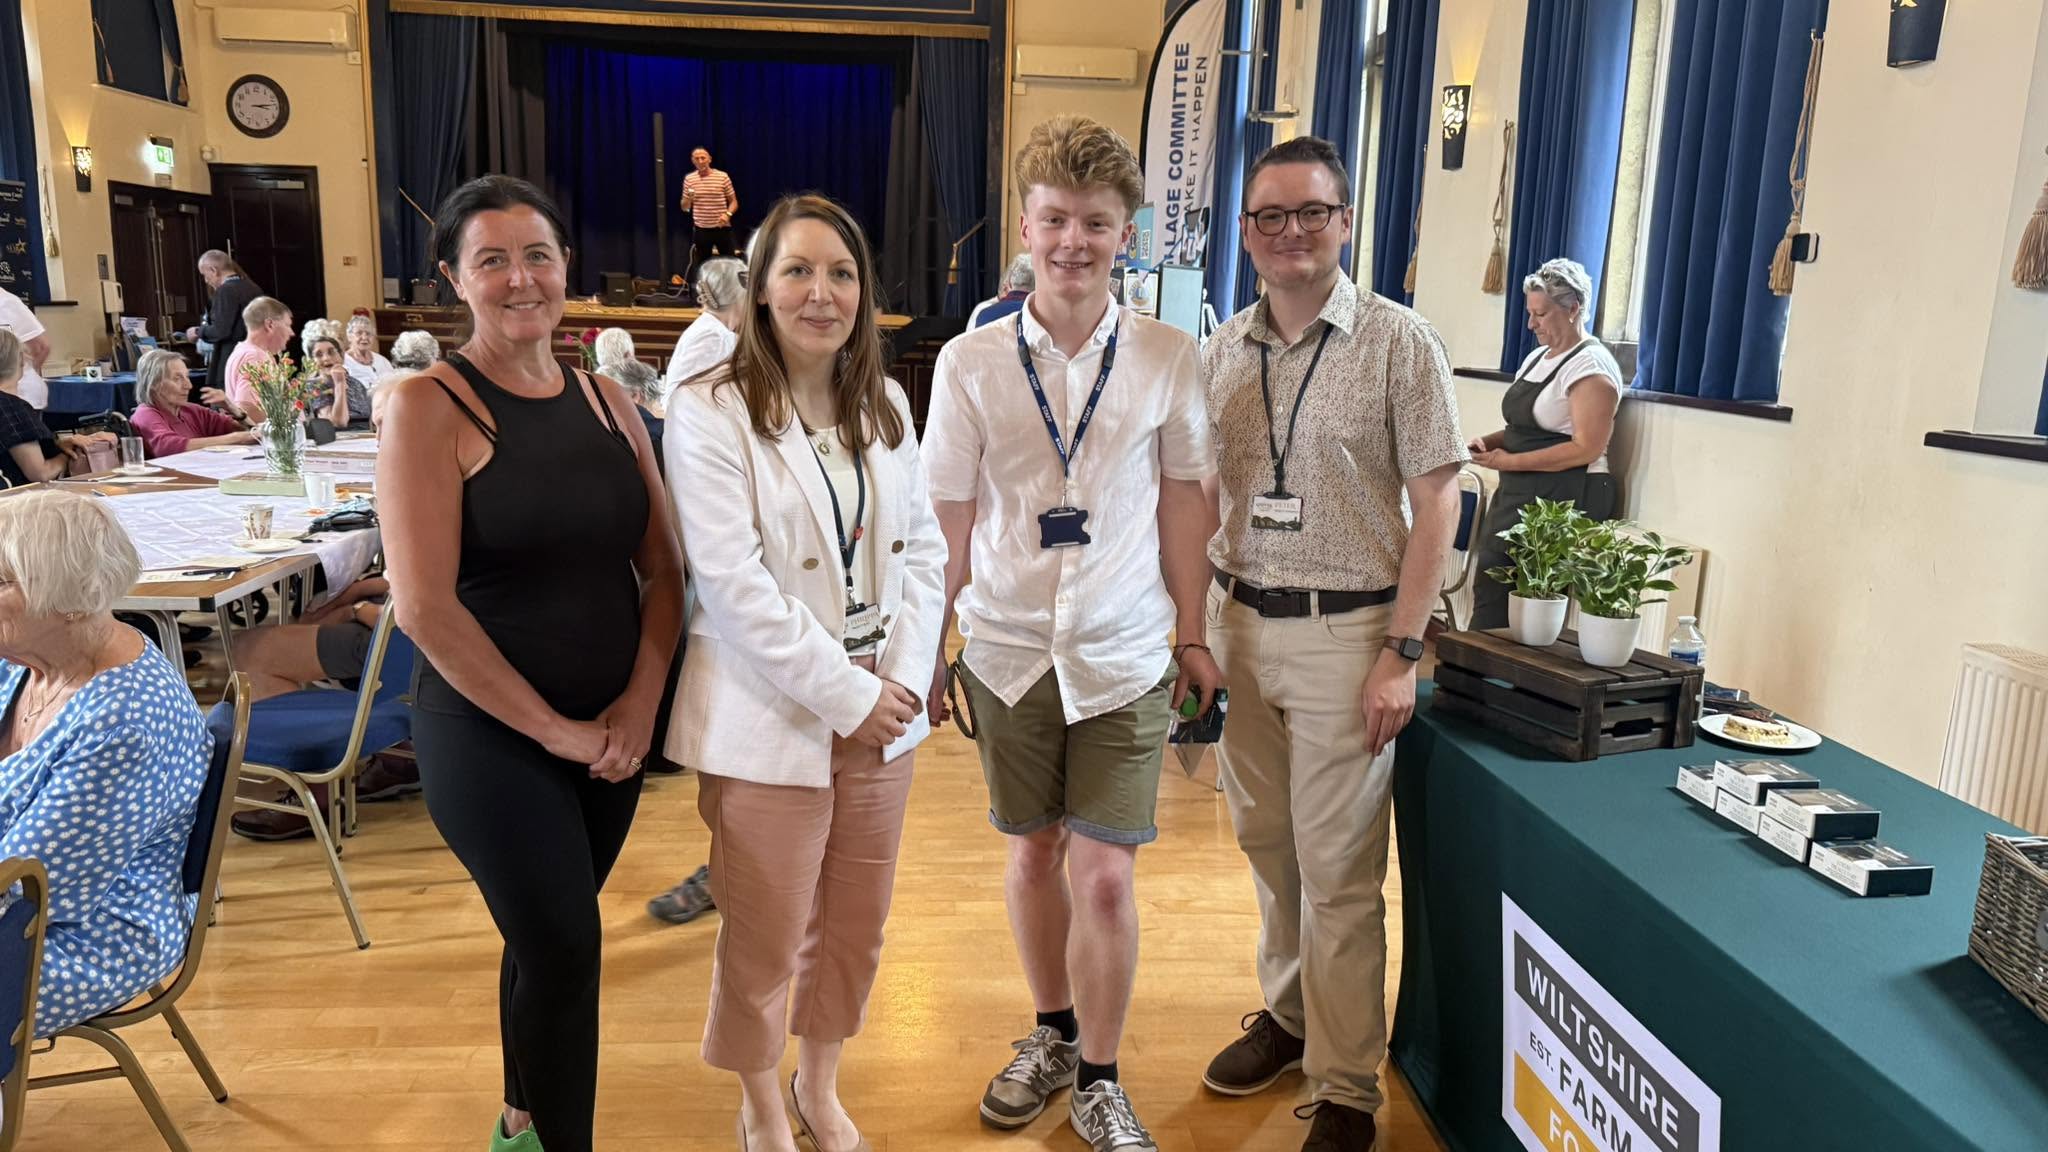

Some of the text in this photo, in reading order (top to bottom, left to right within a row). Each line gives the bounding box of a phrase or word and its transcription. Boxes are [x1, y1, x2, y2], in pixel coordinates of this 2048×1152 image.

[1164, 43, 1189, 265] ILLAGE COMMITTEE
[1184, 56, 1207, 212] AKE IT HAPPEN
[1029, 373, 1040, 391] STAFF
[1042, 405, 1053, 423] STAFF
[1082, 405, 1092, 424] STAFF
[1095, 373, 1106, 391] STAFF
[1526, 957, 1679, 1149] WILTSHIRE
[1530, 1031, 1632, 1152] EST. FARM
